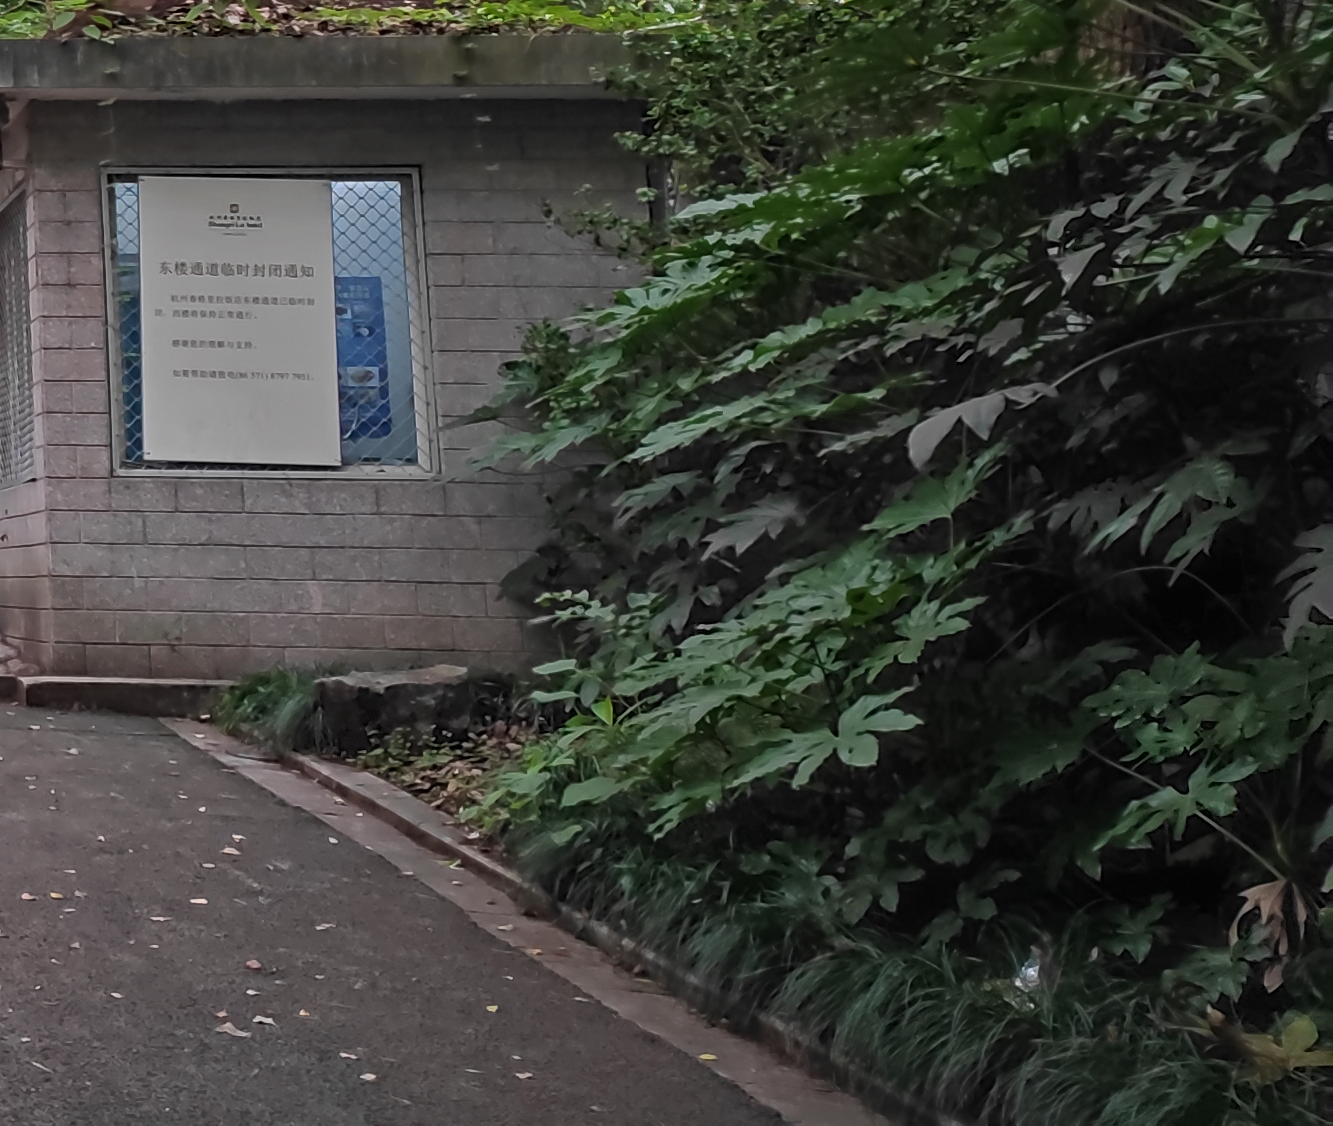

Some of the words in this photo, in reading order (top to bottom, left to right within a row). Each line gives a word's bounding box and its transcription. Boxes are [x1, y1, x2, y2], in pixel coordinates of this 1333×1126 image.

[159, 261, 315, 278] 东楼通道临时封闭通知
